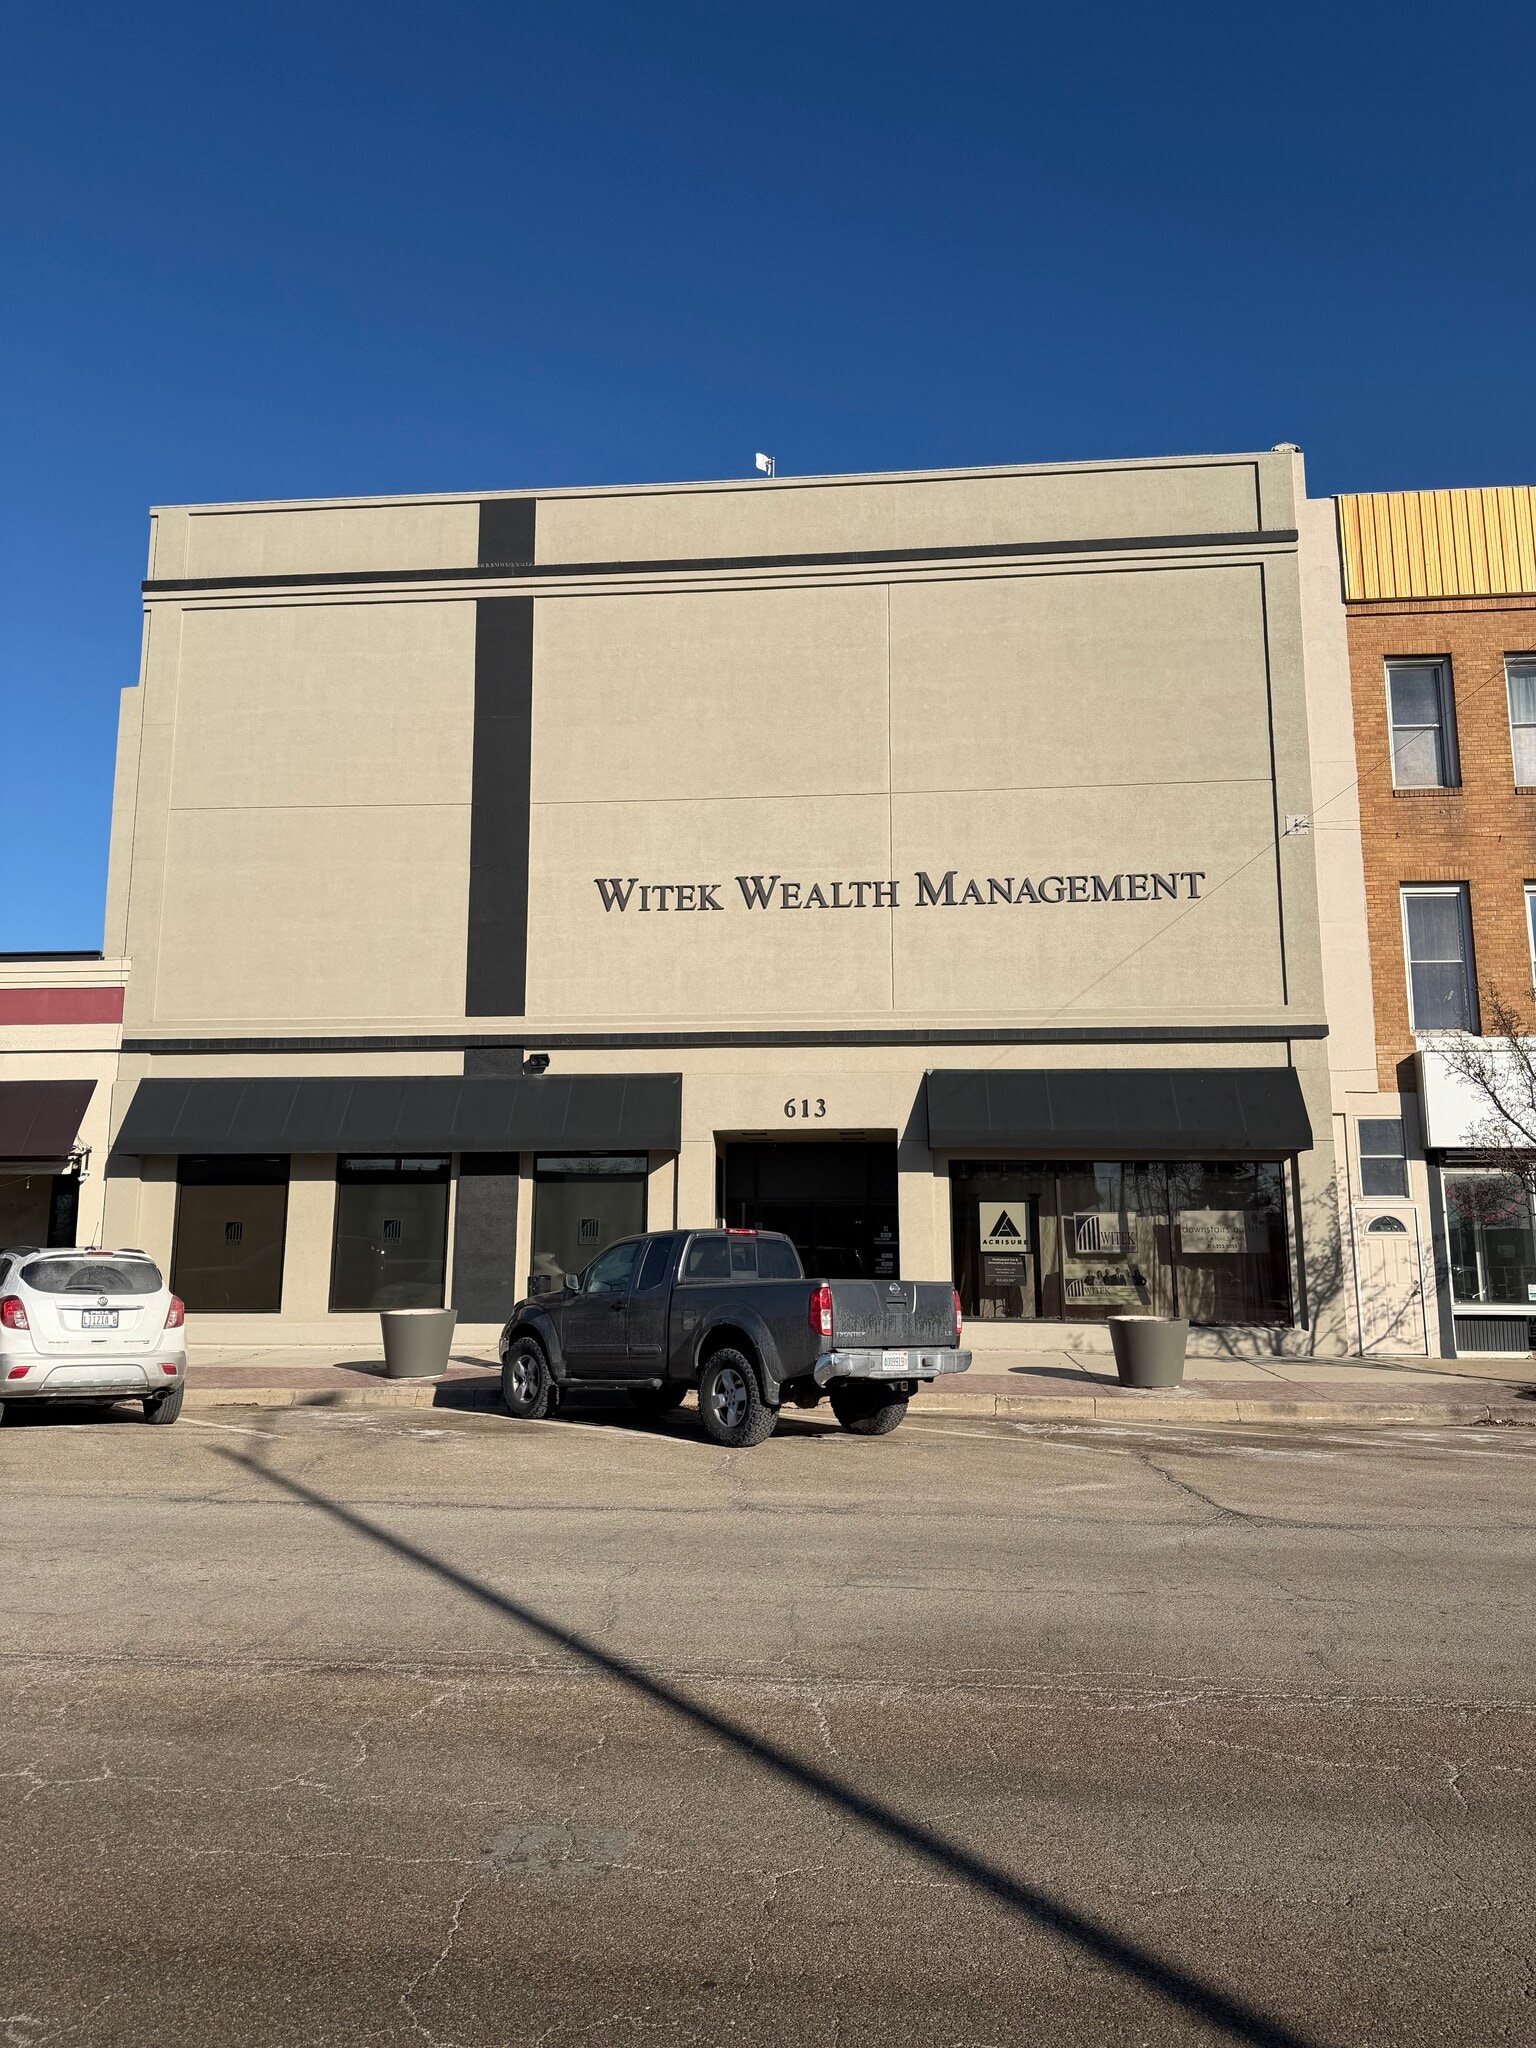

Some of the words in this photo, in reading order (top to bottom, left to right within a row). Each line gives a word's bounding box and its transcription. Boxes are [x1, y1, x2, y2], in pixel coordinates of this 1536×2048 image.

[594, 877, 725, 912] WITEK
[735, 874, 901, 910] WEALTH
[914, 870, 1206, 906] MANAGEMENT
[784, 1098, 827, 1118] 613
[1182, 1223, 1230, 1234] downstairs
[1100, 1231, 1136, 1245] WITEK
[1084, 1287, 1111, 1295] WITEK
